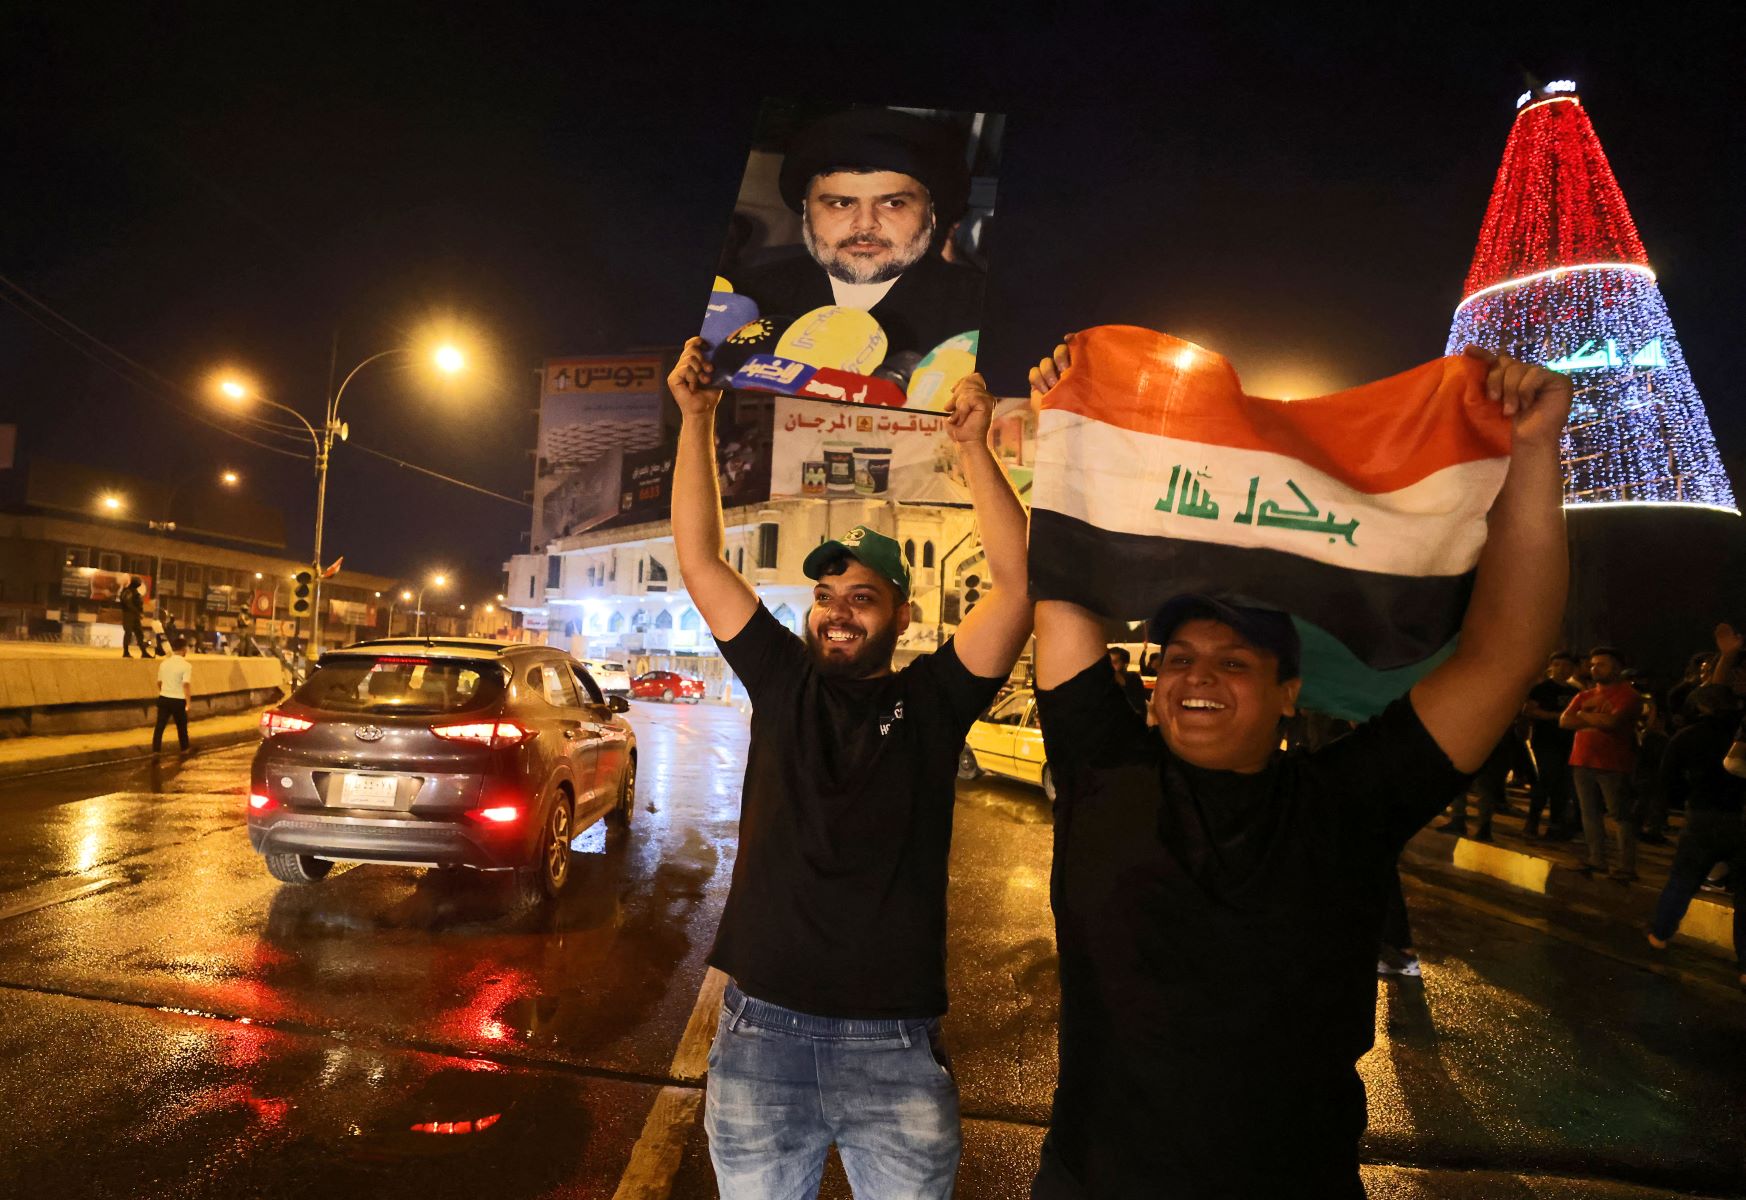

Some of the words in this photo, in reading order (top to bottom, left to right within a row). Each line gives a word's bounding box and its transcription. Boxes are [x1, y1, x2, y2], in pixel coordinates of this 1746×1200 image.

[574, 366, 656, 389] جوتن
[784, 413, 853, 433] المرجان
[877, 415, 944, 436] الياقوت
